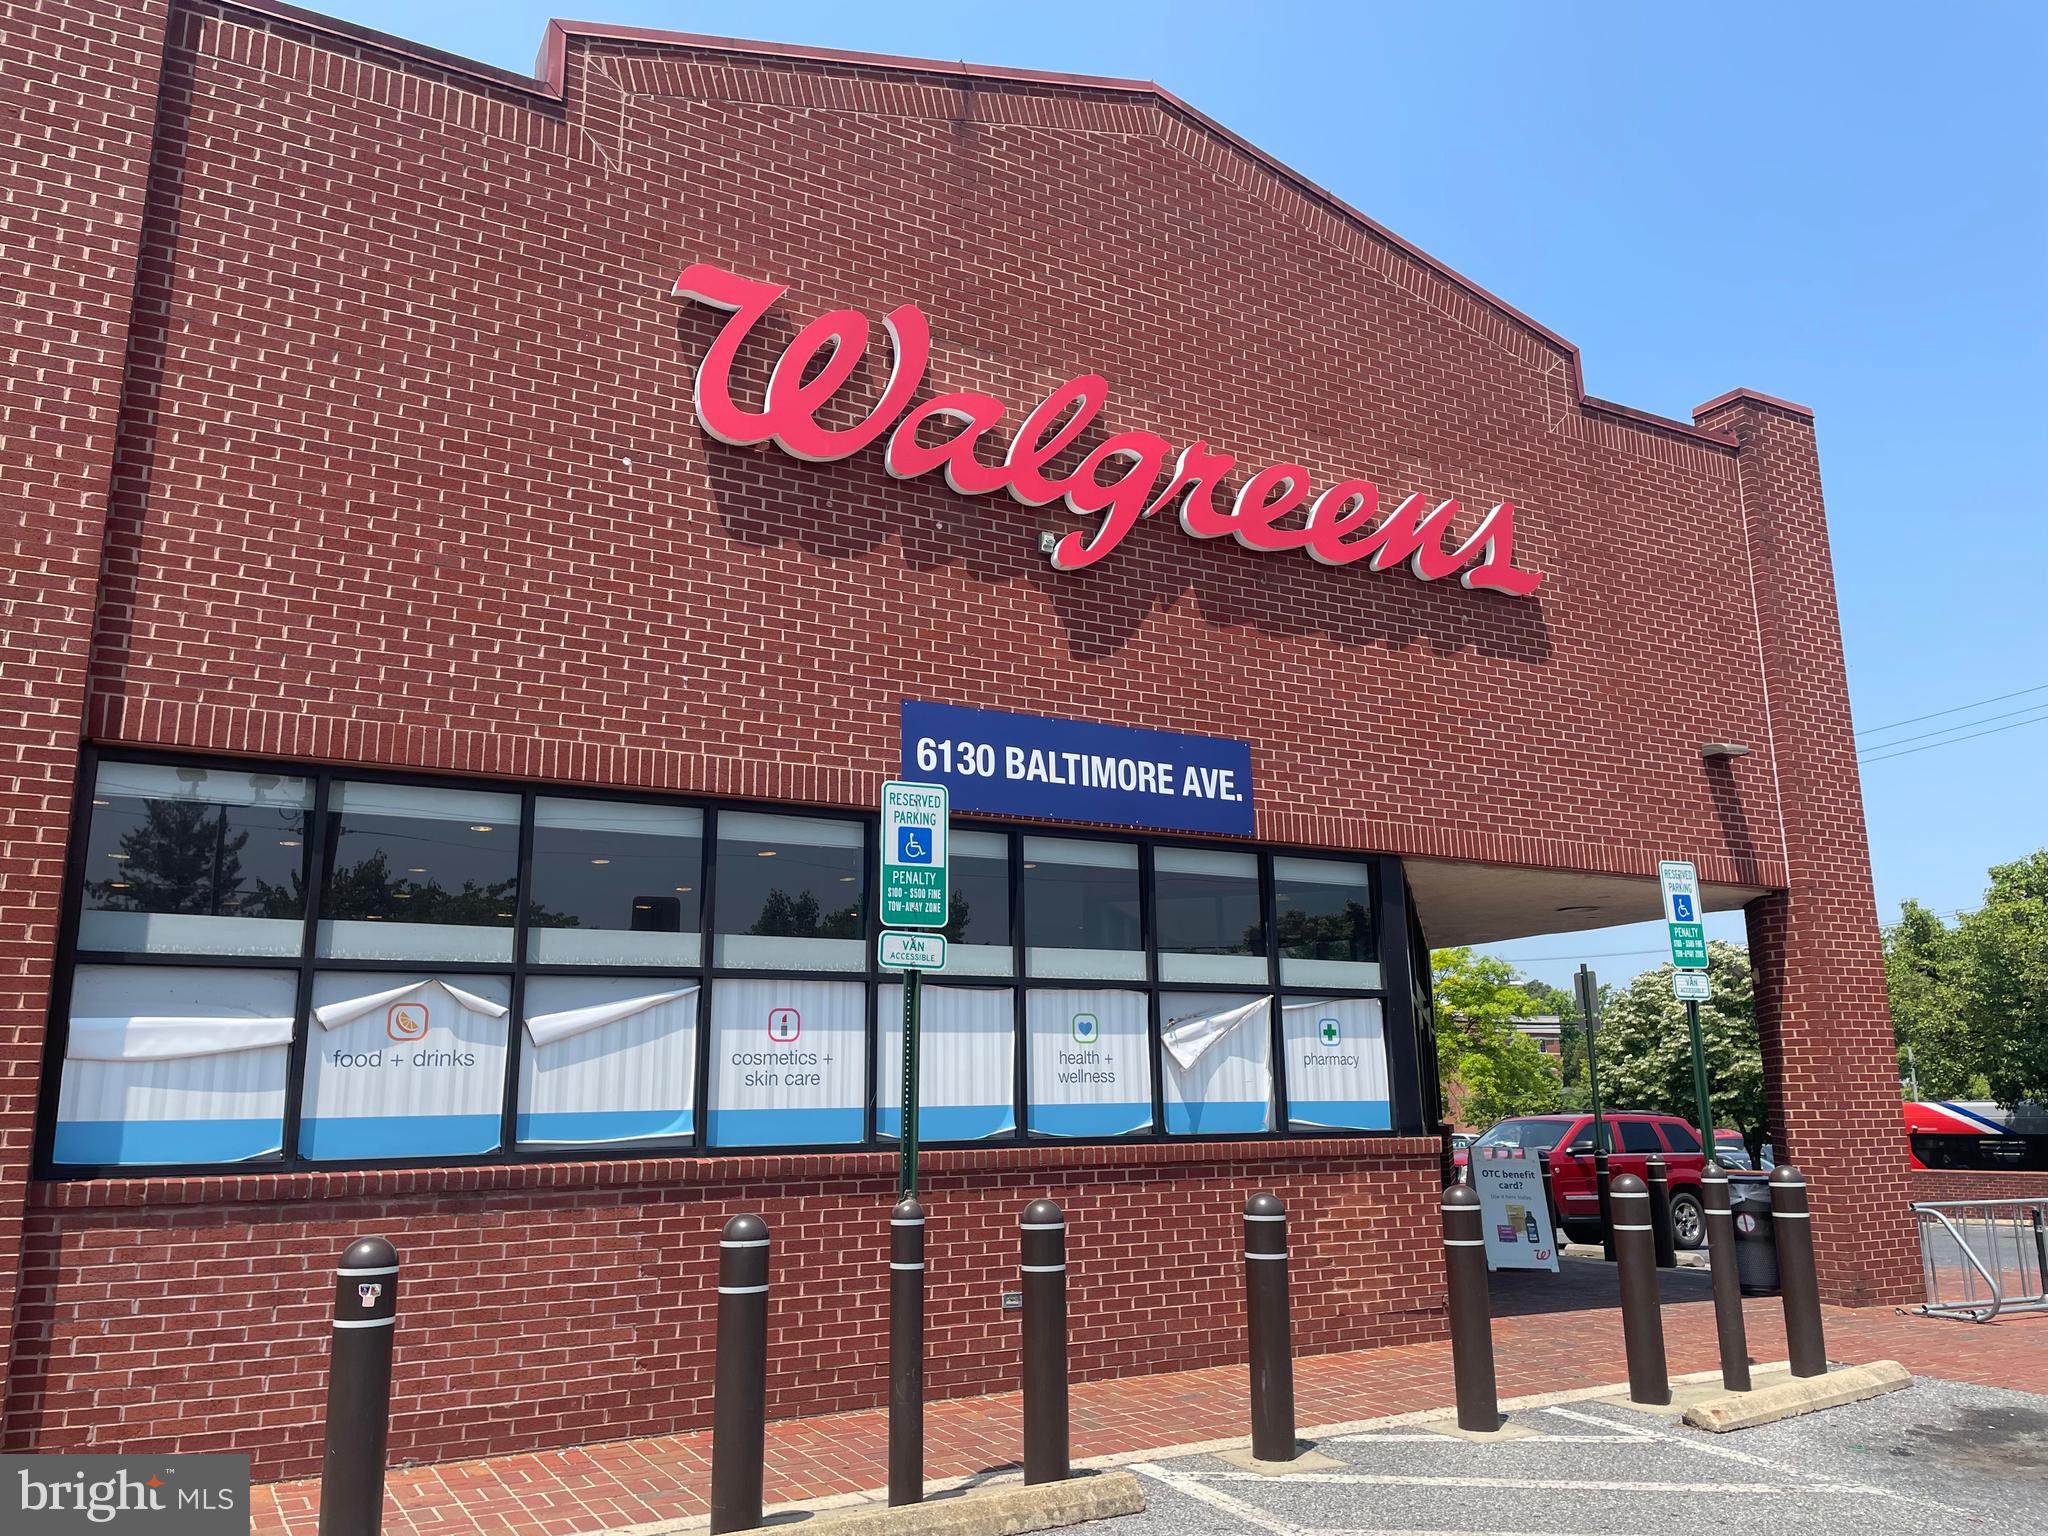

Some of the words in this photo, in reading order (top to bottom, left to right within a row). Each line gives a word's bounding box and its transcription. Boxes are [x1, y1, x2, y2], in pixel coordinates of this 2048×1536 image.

[671, 263, 1543, 597] Walgreens
[916, 737, 996, 777] 6130
[1005, 746, 1175, 796] BALTIMORE
[1182, 766, 1243, 802] AVE.
[889, 792, 942, 809] RESERVED
[893, 810, 937, 826] PARKING
[892, 870, 937, 886] PENALTY
[1663, 868, 1693, 881] RESERVED
[887, 887, 903, 898] $100
[909, 888, 926, 899] $500
[927, 888, 942, 900] FINE
[1668, 882, 1693, 894] PARKING
[887, 900, 923, 913] TOW-AWAY
[924, 901, 942, 913] ZONE
[1673, 926, 1699, 938] PENALTY
[902, 940, 925, 952] VAN
[889, 951, 936, 962] ACCESSIBLE
[333, 1049, 382, 1068] food
[390, 1054, 404, 1067] +
[412, 1049, 475, 1067] drinks
[731, 1049, 818, 1066] cosmetics
[823, 1053, 833, 1065] +
[1059, 1050, 1100, 1065] health
[1104, 1053, 1113, 1064] +
[1303, 1052, 1360, 1069] pharmacy
[744, 1070, 778, 1086] skin
[784, 1072, 821, 1086] care
[1057, 1068, 1116, 1083] wellness
[1482, 1169, 1500, 1178] OTC
[1502, 1170, 1536, 1179] benefit
[1498, 1181, 1523, 1190] card?
